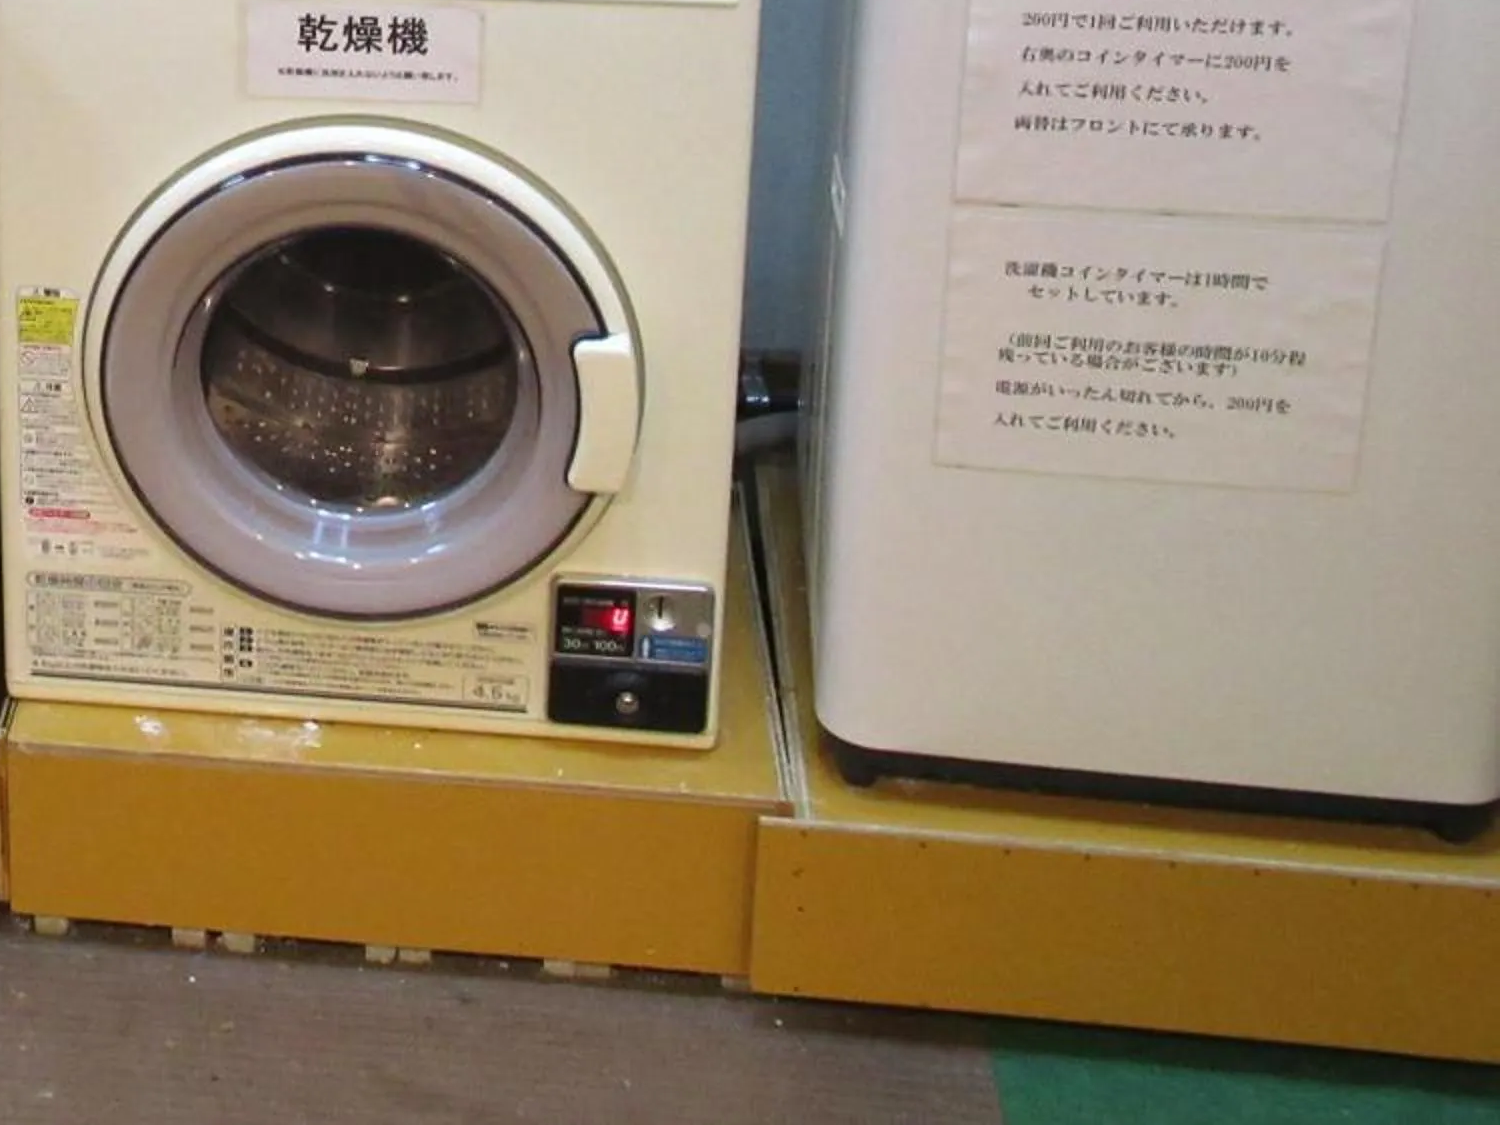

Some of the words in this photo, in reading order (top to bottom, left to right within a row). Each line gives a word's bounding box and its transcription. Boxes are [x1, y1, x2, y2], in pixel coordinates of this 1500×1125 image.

[297, 13, 429, 56] 乾燥機
[1021, 11, 1295, 38] 200円で1回ご利用いただけます。
[1022, 45, 1292, 73] 右奥のコインタイマーに200円を
[1018, 82, 1209, 106] 入れてご利用ください。
[1014, 116, 1263, 143] 両替はフロントにて承ります。
[1004, 260, 1269, 292] 洗濯機コインタイマーは1時間で
[1027, 283, 1180, 309] セットしています。
[994, 379, 1292, 415] 電源がいったん切れてから、200円を
[994, 413, 1177, 440] 入れてご利用ください。
